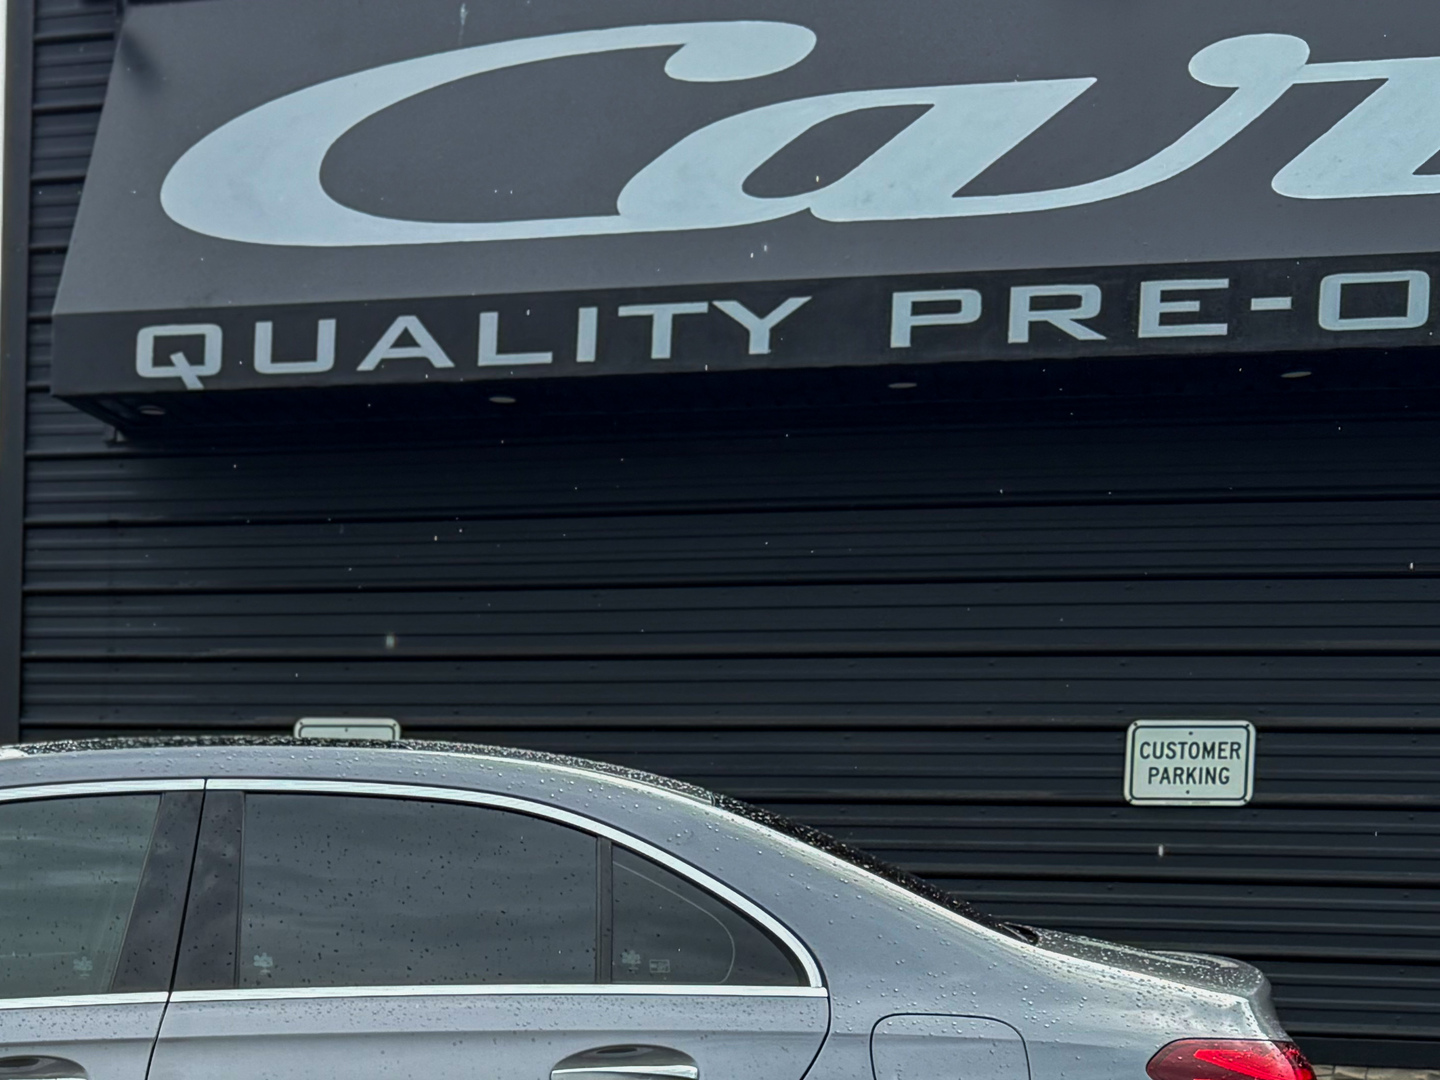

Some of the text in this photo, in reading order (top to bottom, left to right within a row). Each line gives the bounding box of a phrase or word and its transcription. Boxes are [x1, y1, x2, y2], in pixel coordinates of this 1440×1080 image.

[136, 270, 1431, 389] QUALITY PRE-O
[1139, 741, 1242, 760] CUSTOMER
[1147, 766, 1231, 785] PARKING
